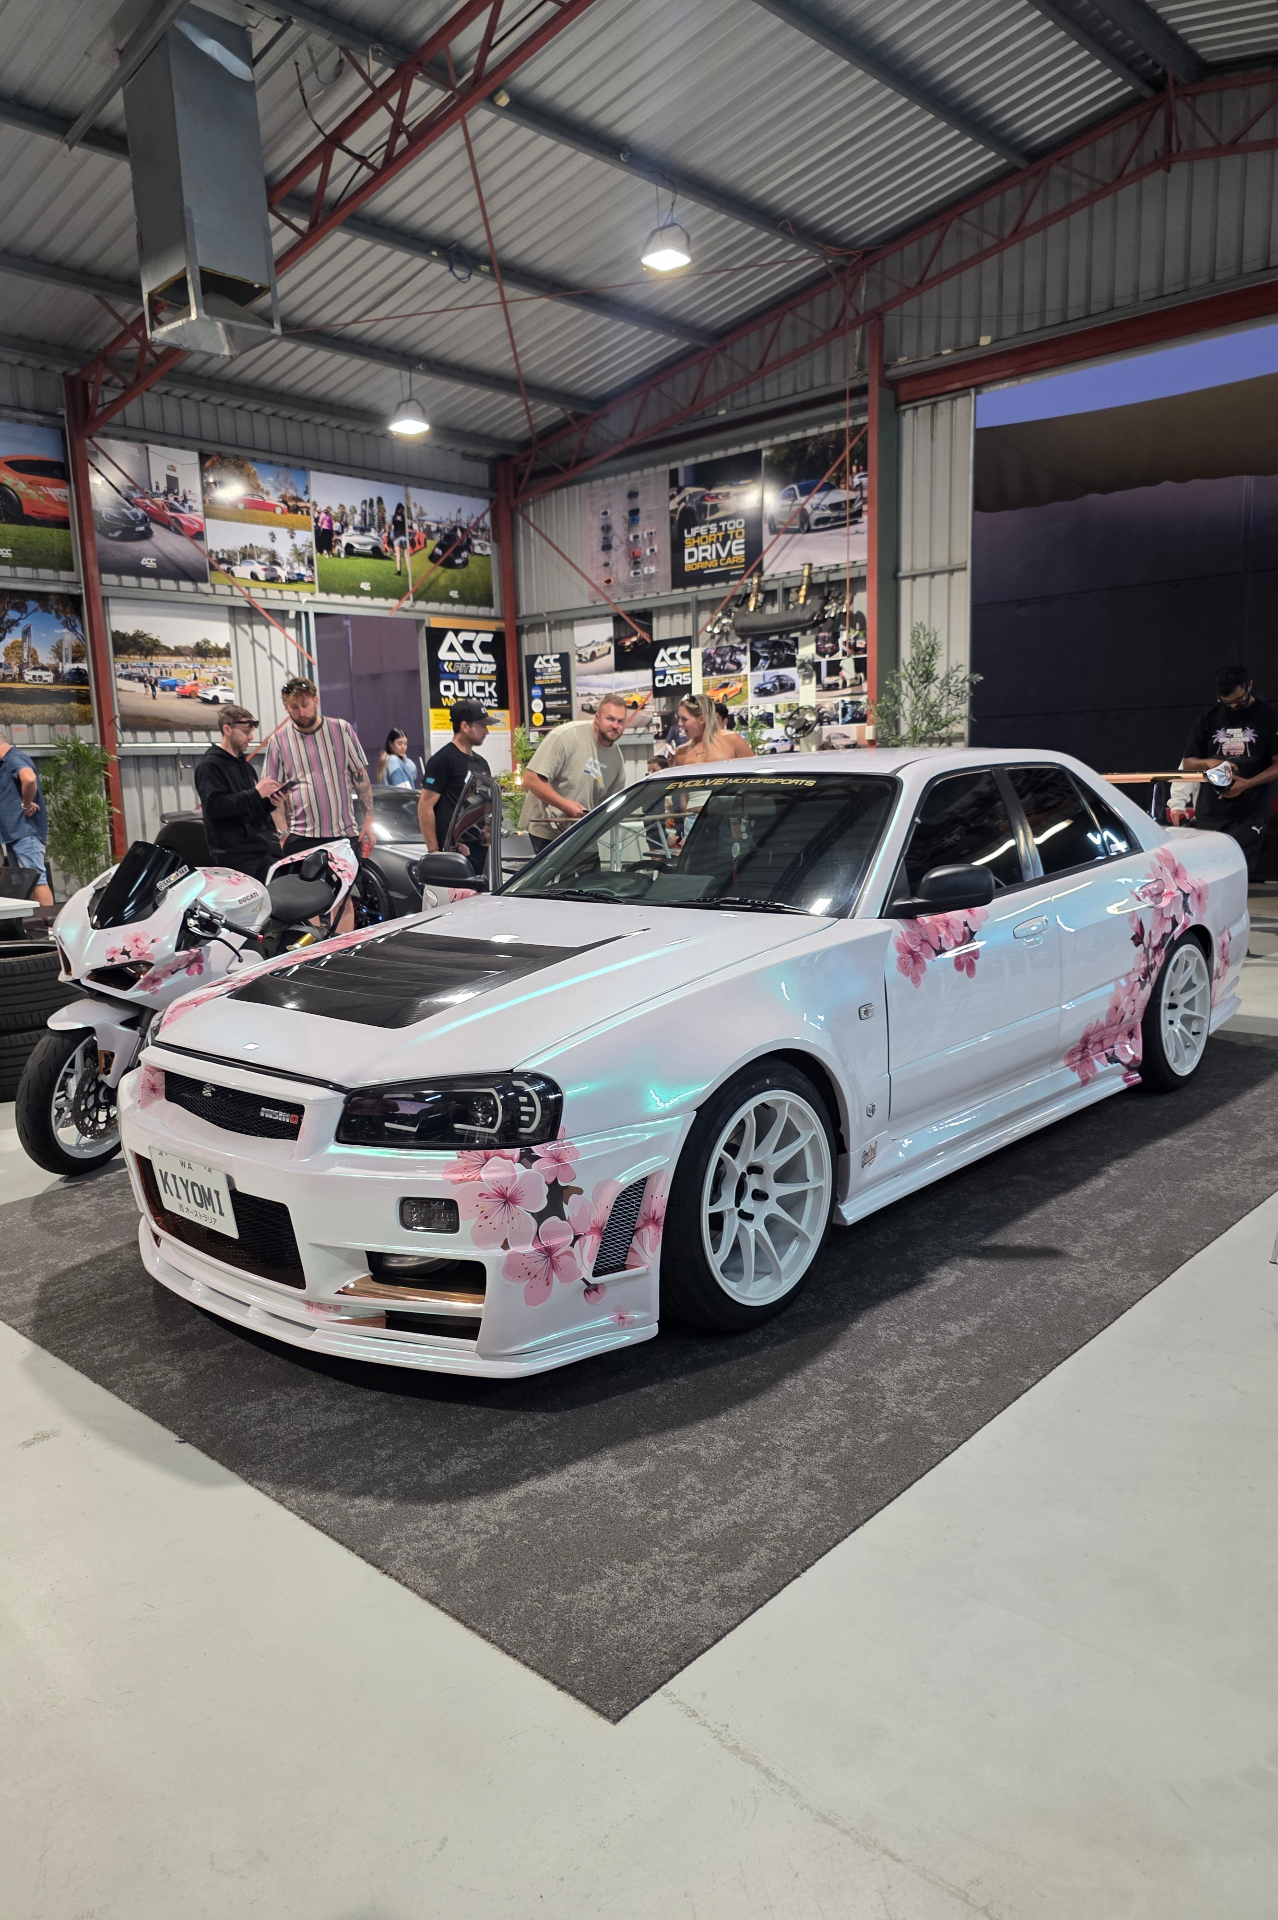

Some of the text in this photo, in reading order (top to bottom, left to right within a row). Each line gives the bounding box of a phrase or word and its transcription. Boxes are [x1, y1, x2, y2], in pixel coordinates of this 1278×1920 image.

[684, 518, 745, 538] LIFE'S TOO
[684, 528, 745, 548] SHORT TO
[684, 538, 745, 564] DRIVE
[684, 555, 745, 572] BORING CARS
[437, 630, 495, 662] ACC
[533, 654, 560, 668] ACC
[654, 645, 690, 667] ACC
[453, 662, 497, 674] PITSTOP
[439, 680, 498, 699] QUICK
[655, 672, 692, 688] CARS
[665, 777, 817, 790] EVOLVE MOTORSPORTS
[238, 891, 259, 905] DUCATI
[179, 1159, 193, 1171] WA
[158, 1168, 225, 1217] KIYOMI
[178, 1203, 217, 1225] 西オーストラリア
